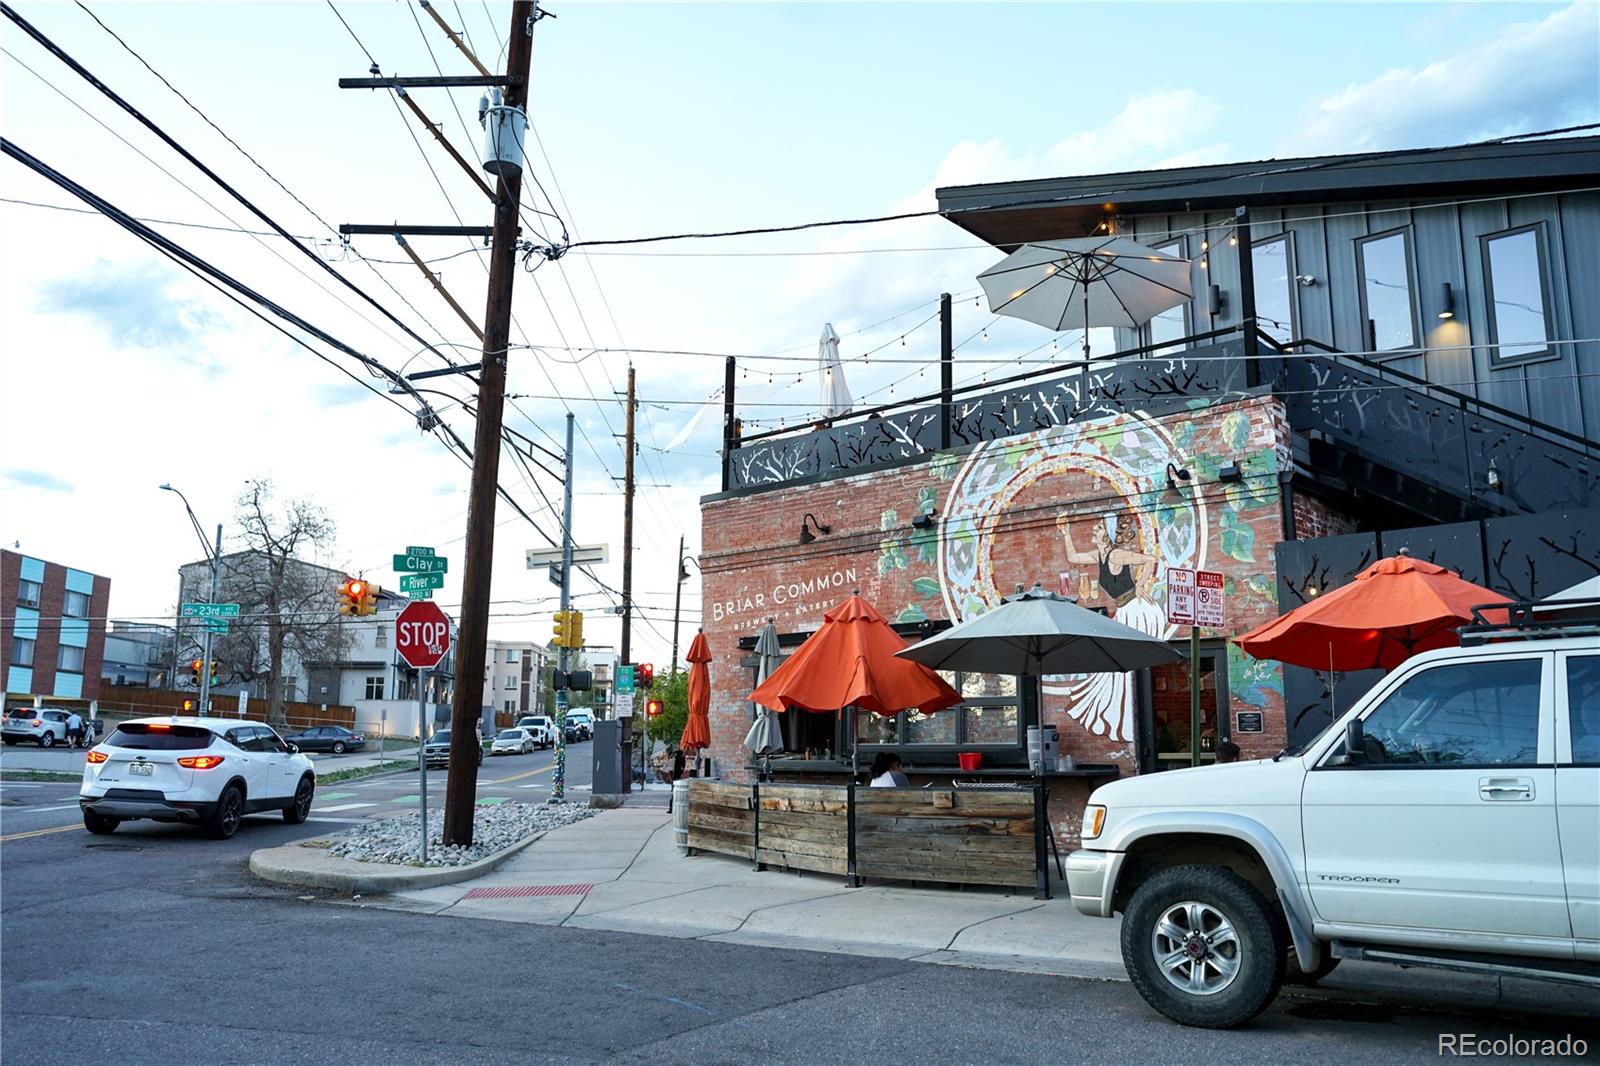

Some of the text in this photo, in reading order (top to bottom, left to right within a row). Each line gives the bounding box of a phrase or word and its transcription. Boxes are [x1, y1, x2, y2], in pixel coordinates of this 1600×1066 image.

[406, 556, 433, 572] Clay
[409, 576, 428, 589] River
[1175, 572, 1187, 583] NO
[1200, 573, 1220, 582] STREET
[1199, 580, 1221, 588] SWEEPING
[410, 591, 424, 599] 2250
[713, 568, 857, 621] BRIAR COMMON
[1169, 584, 1194, 596] PARKING
[1210, 589, 1221, 597] THIS
[1175, 595, 1187, 603] ANY
[1210, 597, 1221, 605] SIDE
[199, 606, 220, 616] 23rd
[796, 599, 835, 615] EATERY
[1175, 603, 1188, 612] TIME
[400, 622, 446, 646] STOP
[1318, 874, 1400, 884] TROOPER
